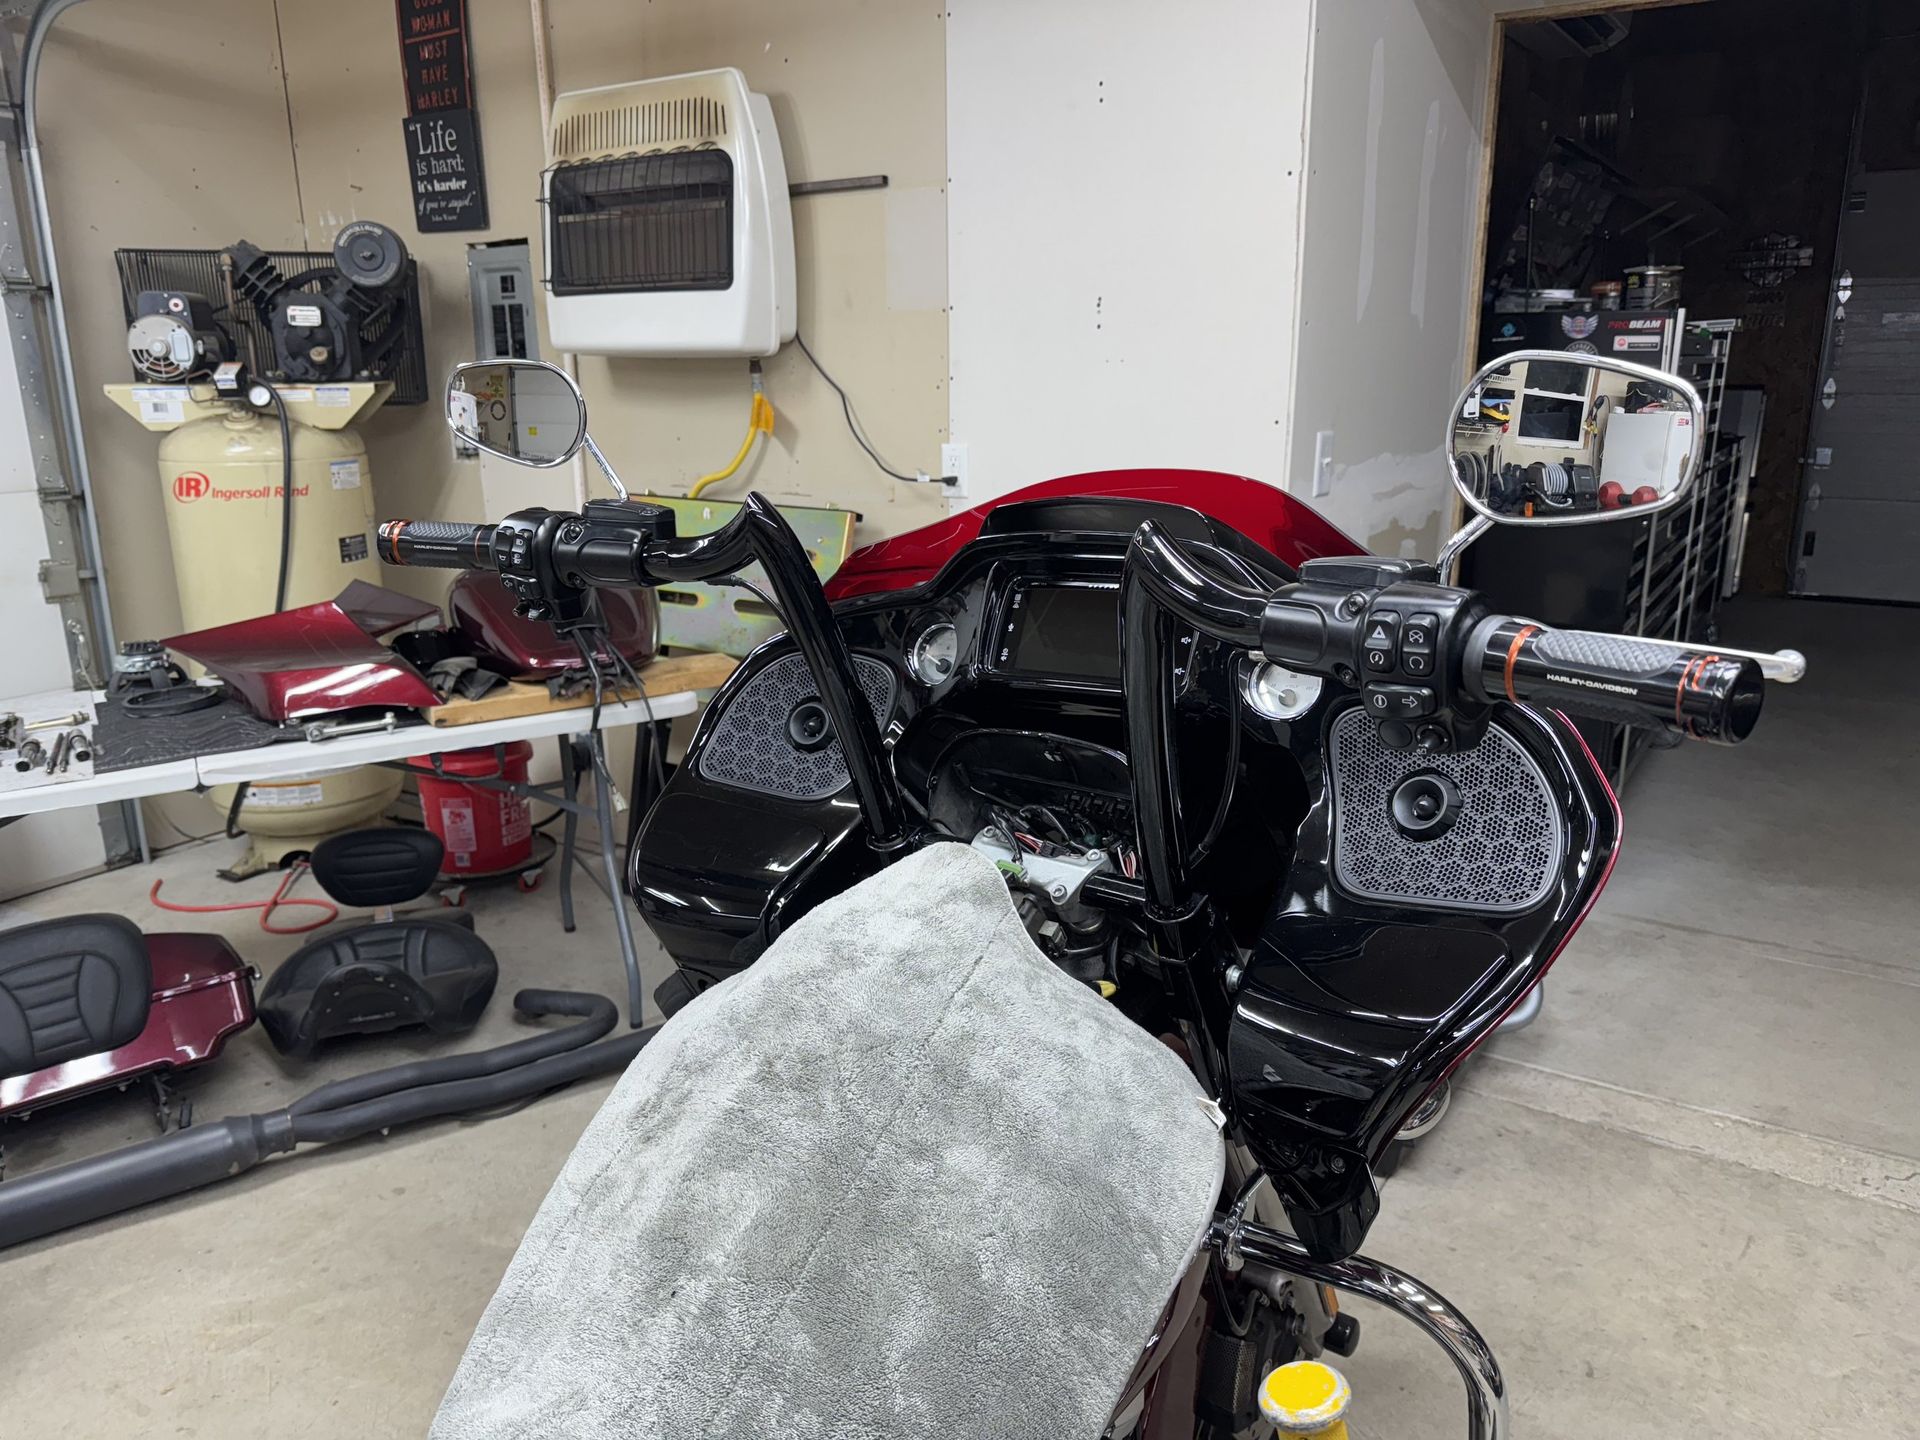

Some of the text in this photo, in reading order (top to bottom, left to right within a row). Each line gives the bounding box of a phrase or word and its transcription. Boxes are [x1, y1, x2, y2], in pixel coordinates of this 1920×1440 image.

[411, 10, 450, 32] WOMAN
[419, 40, 448, 60] MUST
[421, 64, 448, 85] HAVE
[416, 87, 458, 109] HARLEY
[416, 159, 428, 176] is
[433, 177, 467, 192] harder
[212, 484, 309, 501] Ingersoll Rnd
[413, 544, 458, 552] HARLEY-DAVIDSON
[1546, 673, 1639, 696] HARLEY-DAVIDSON
